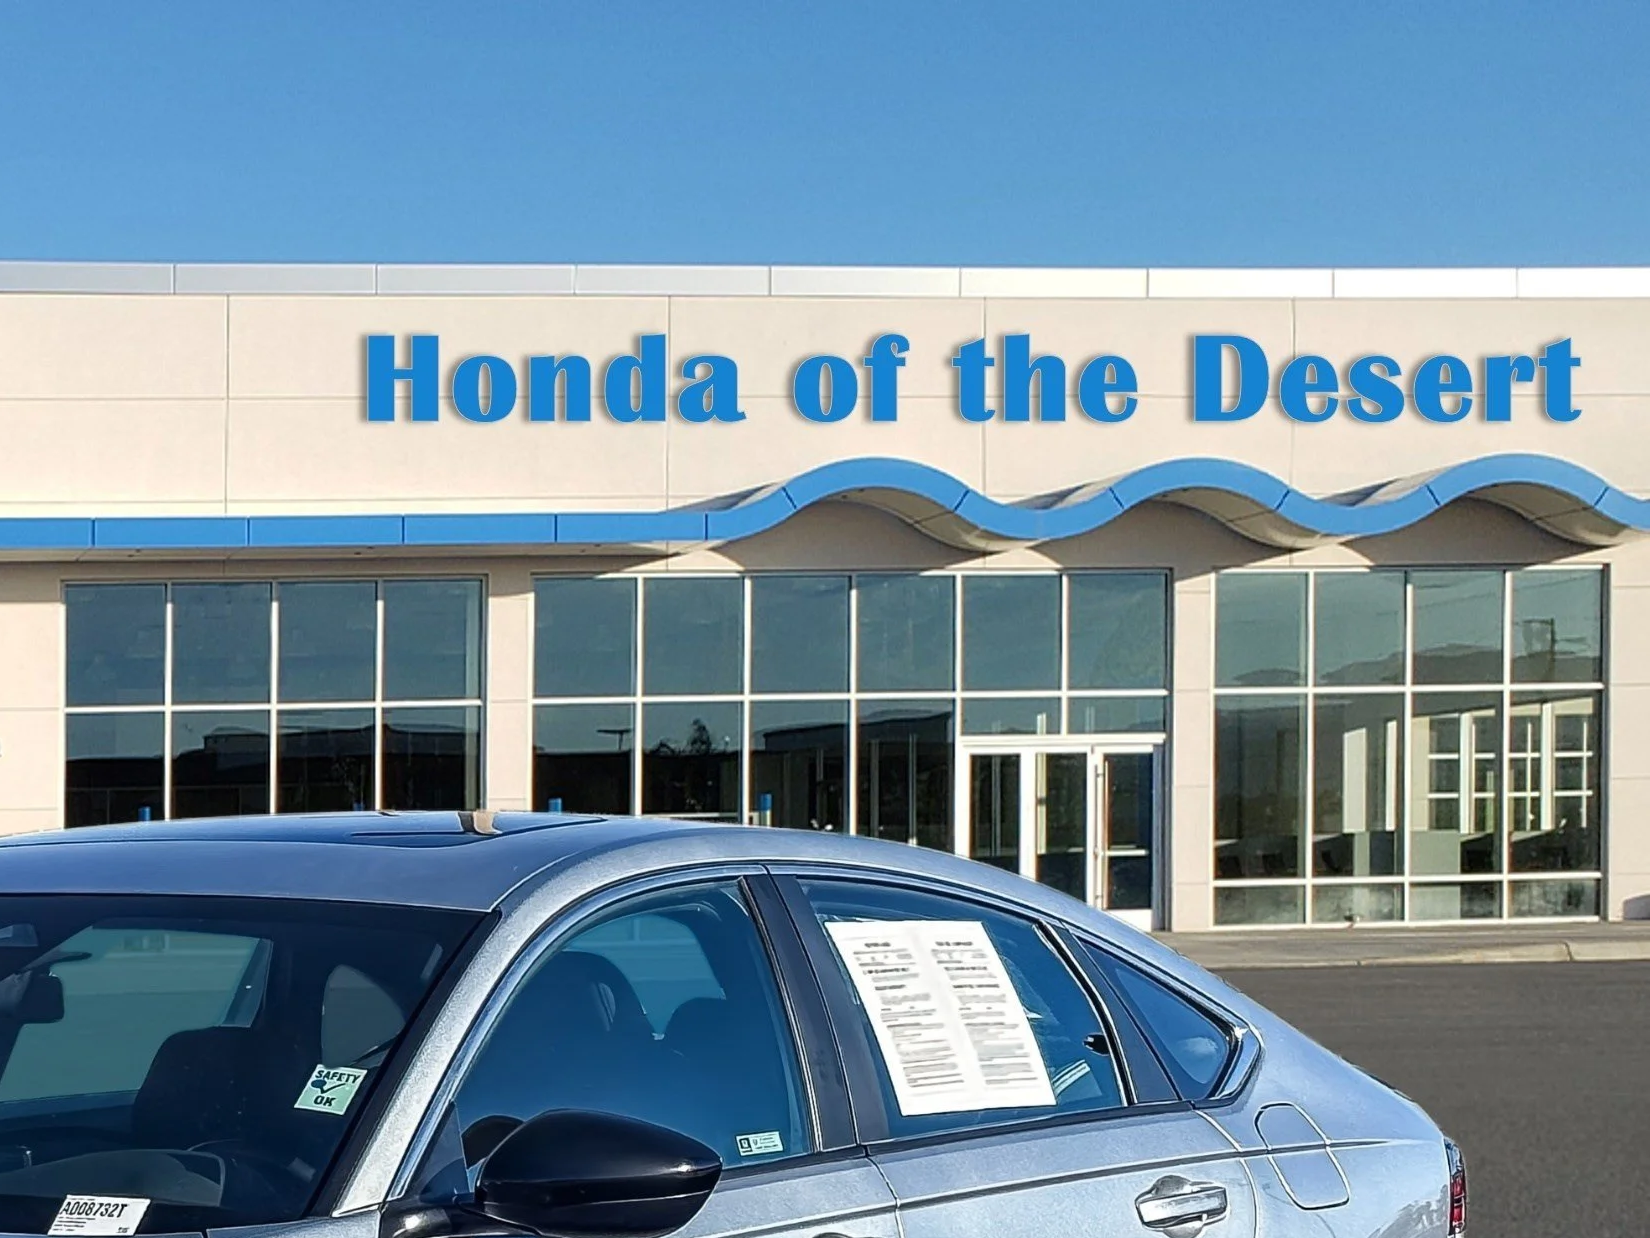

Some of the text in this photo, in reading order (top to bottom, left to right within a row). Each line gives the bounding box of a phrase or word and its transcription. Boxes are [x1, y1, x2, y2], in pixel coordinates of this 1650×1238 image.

[367, 333, 1582, 423] Honda of the Desert
[314, 1069, 361, 1084] SAFETY
[313, 1095, 337, 1107] OK
